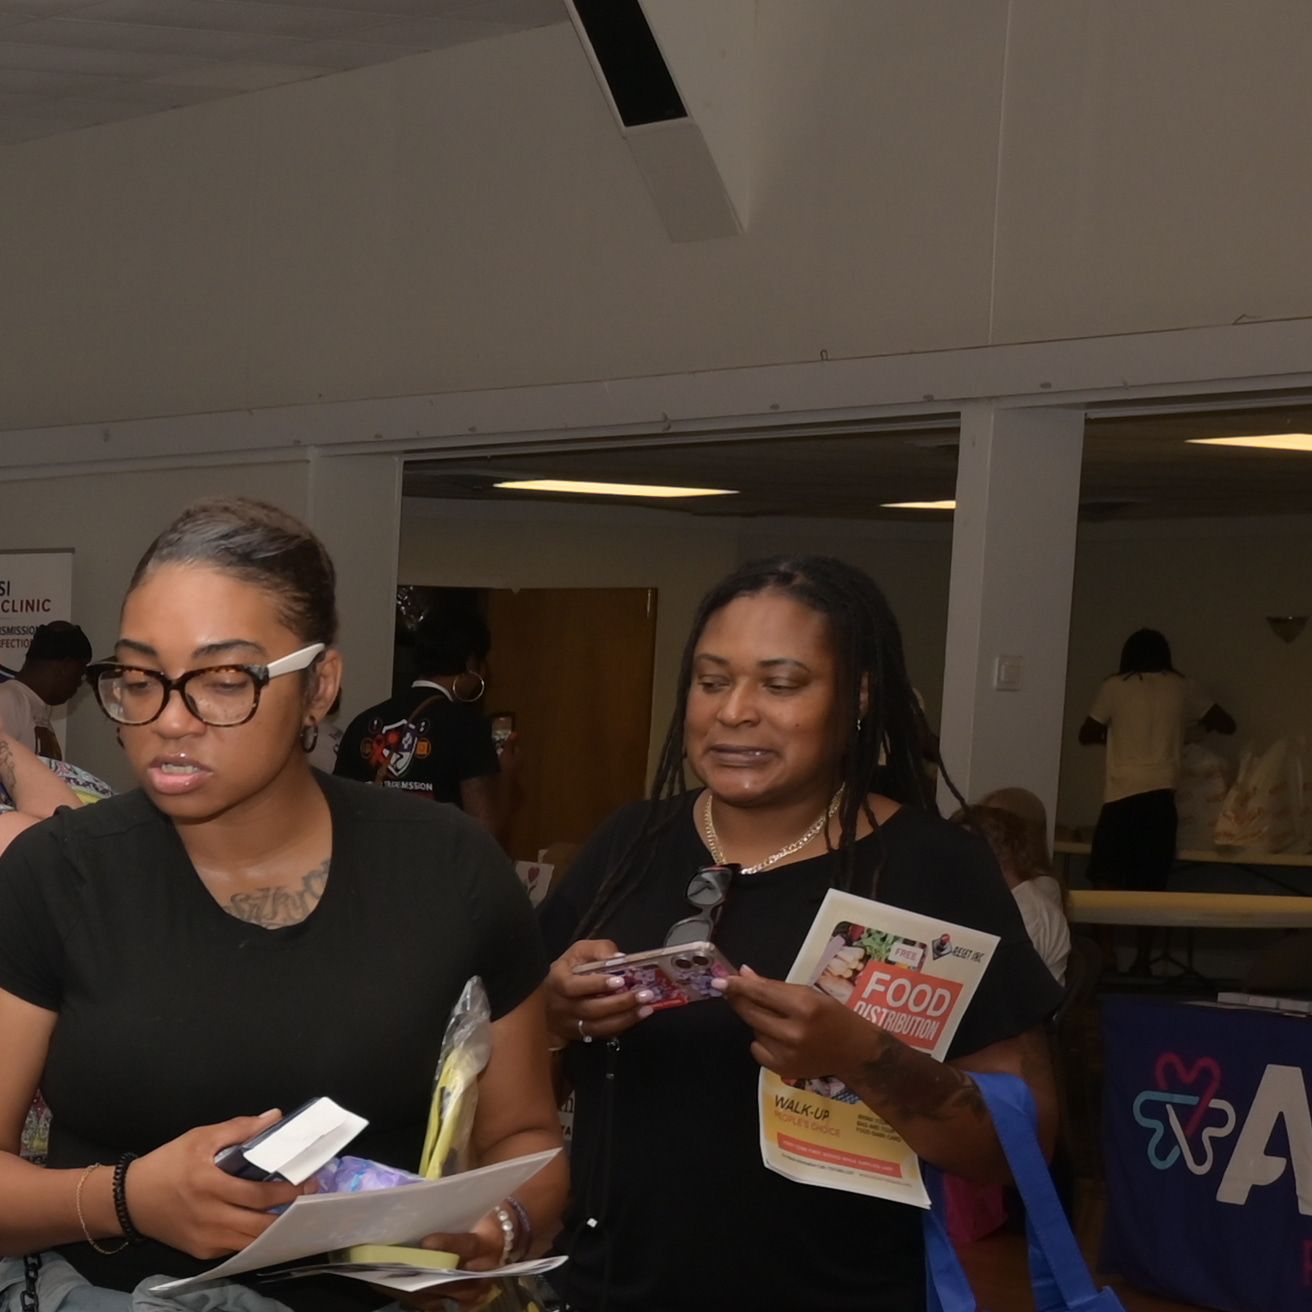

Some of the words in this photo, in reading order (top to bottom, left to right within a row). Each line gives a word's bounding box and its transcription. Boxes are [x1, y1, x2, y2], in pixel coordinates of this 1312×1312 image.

[0, 598, 52, 613] CLINIC
[862, 970, 951, 1018] FOOD
[854, 1000, 940, 1041] DISTRIBUTION
[775, 1094, 830, 1120] WALK-UP
